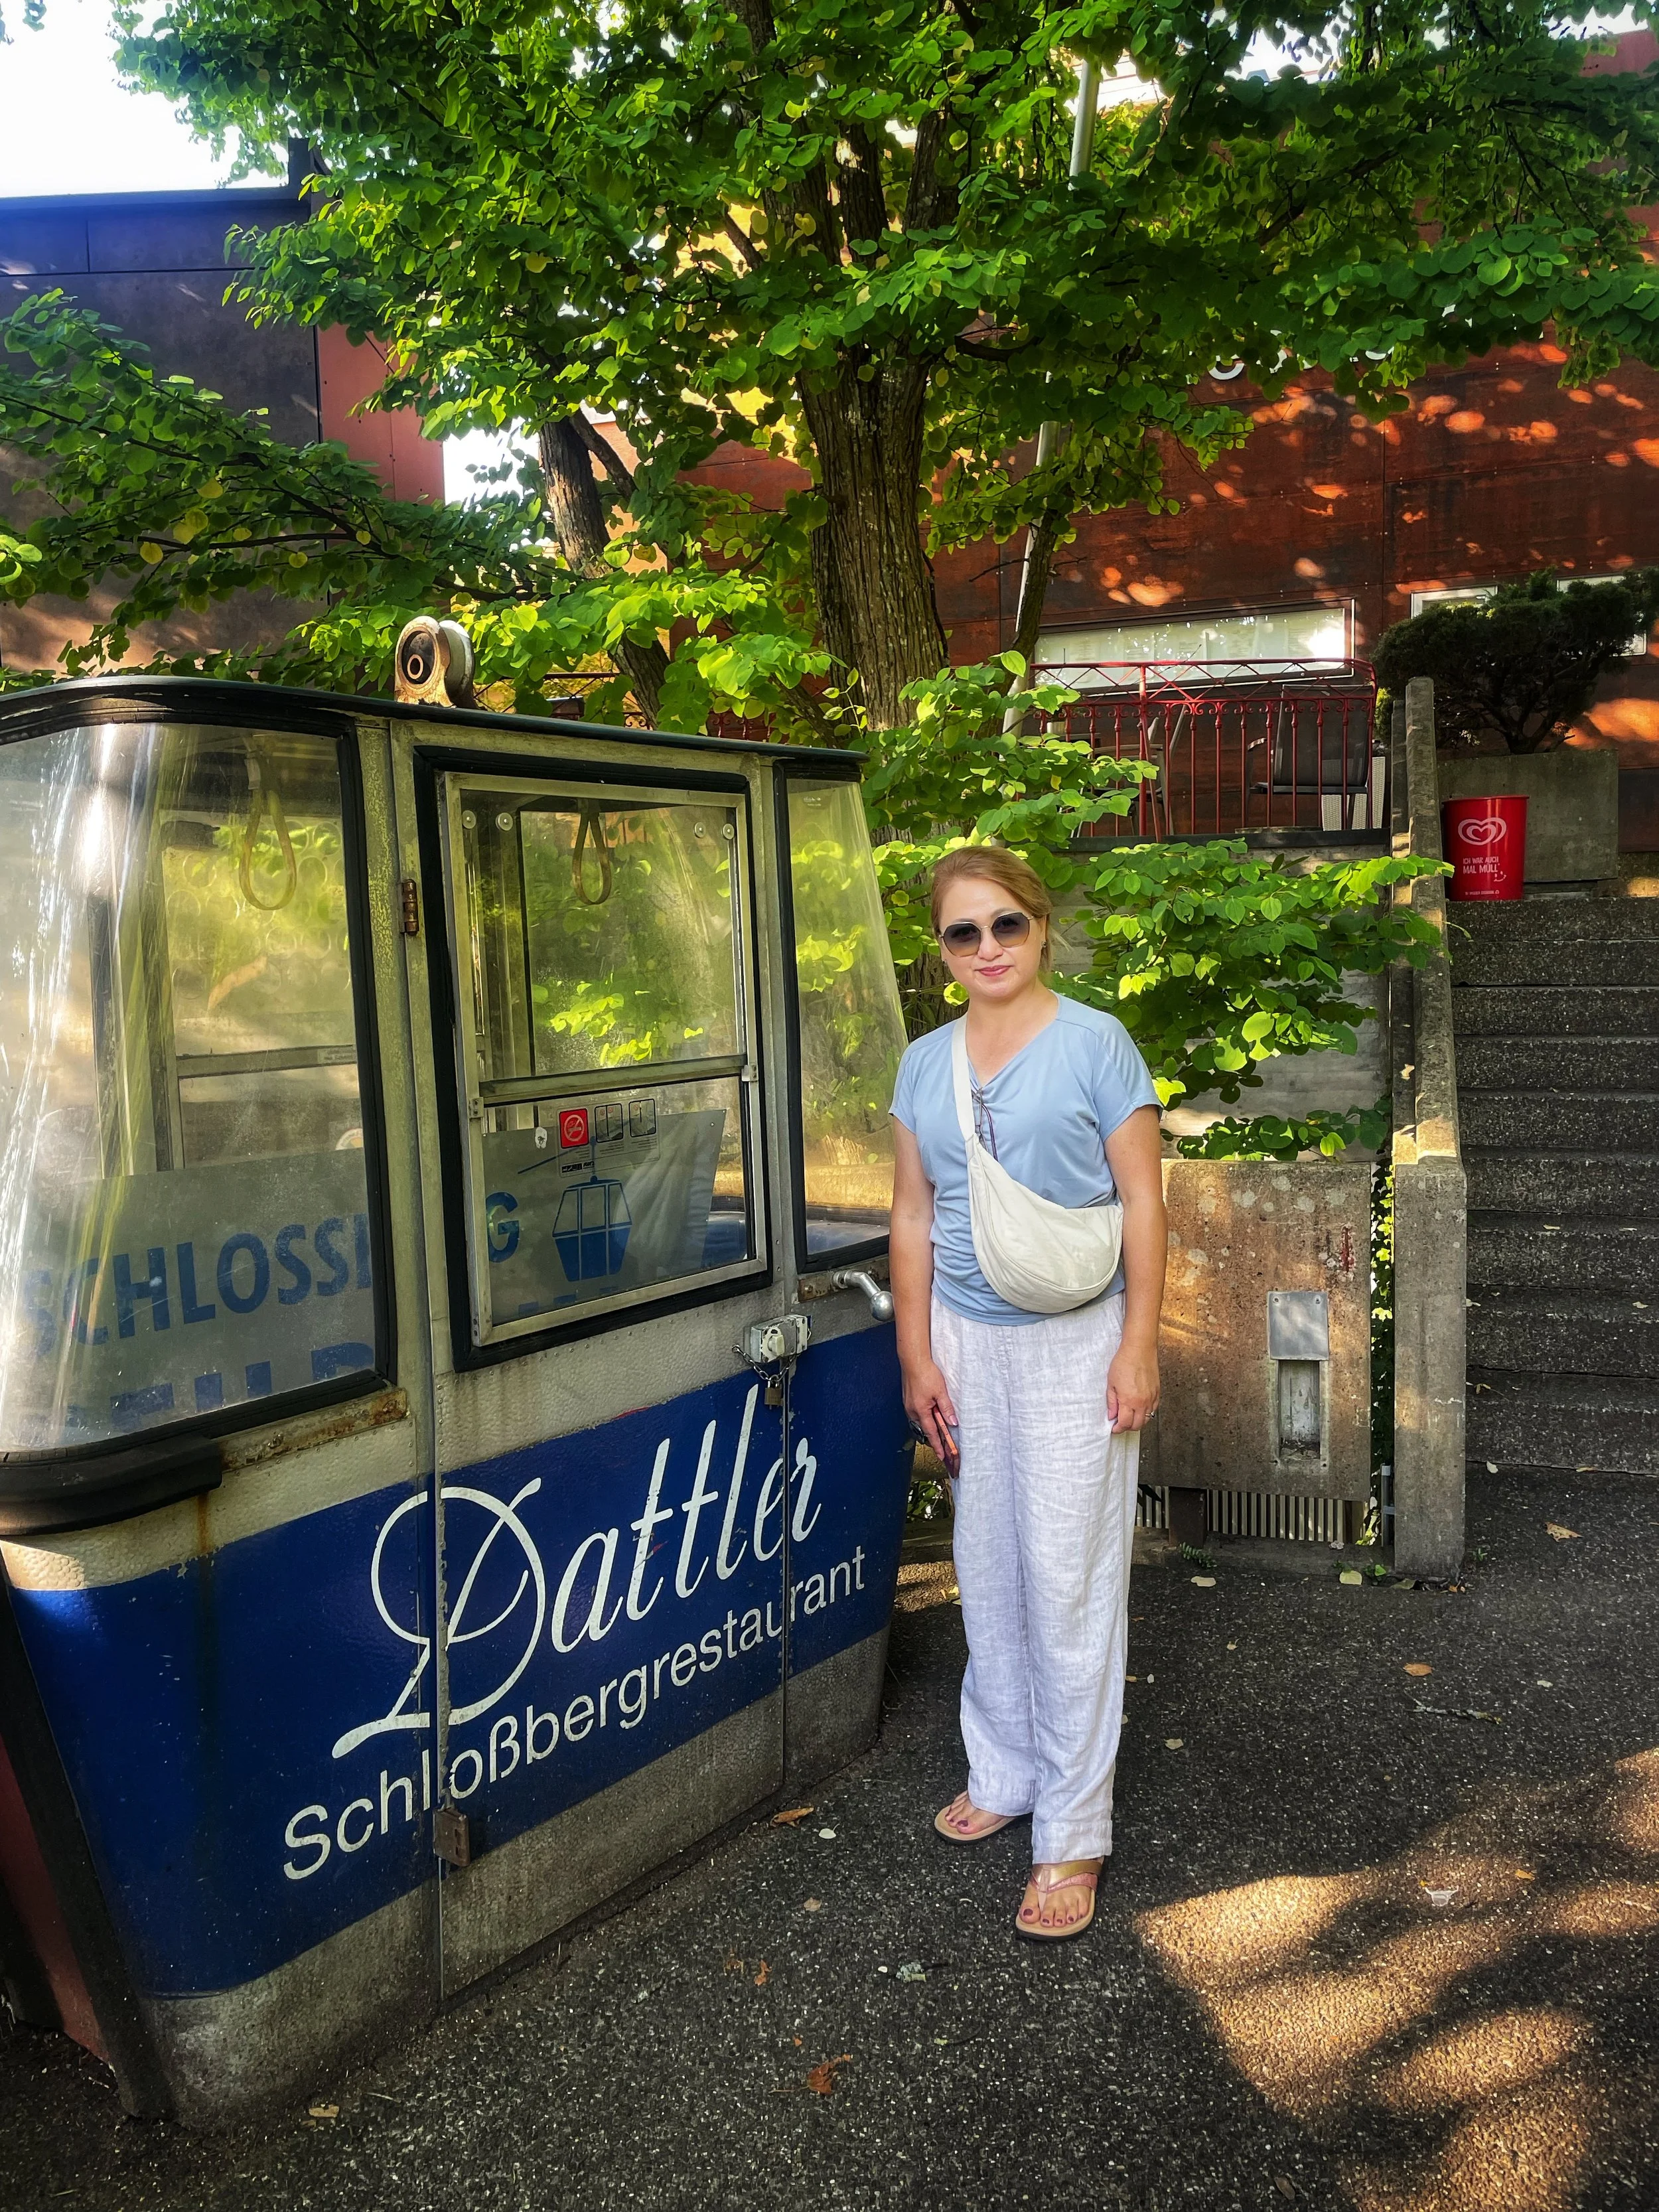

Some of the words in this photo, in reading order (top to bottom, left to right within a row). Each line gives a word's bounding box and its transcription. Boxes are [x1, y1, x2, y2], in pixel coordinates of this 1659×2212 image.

[1463, 865, 1477, 874] MAL
[283, 1546, 865, 1880] Schloßbergrestaurant
[332, 1383, 822, 1759] Dattler
